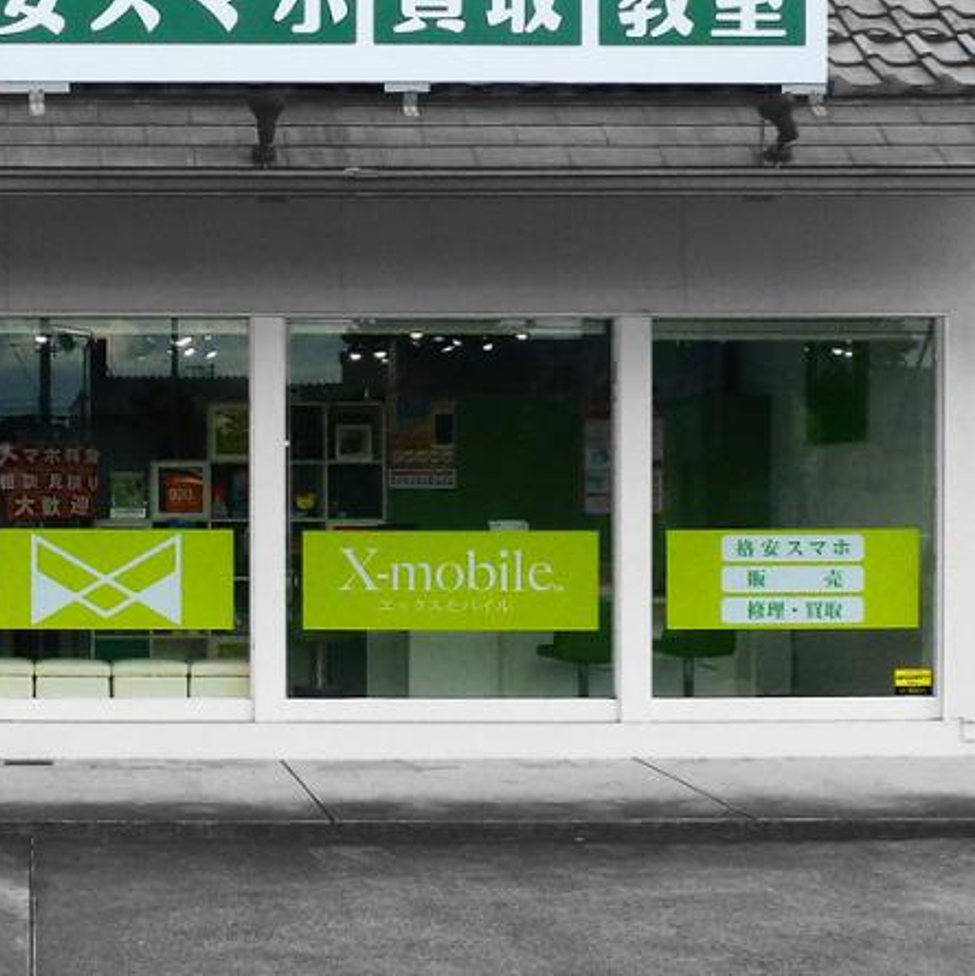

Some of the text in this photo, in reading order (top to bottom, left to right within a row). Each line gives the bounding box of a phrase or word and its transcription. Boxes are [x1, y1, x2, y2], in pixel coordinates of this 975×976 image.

[737, 539, 851, 557] 格安スマホ
[340, 547, 554, 592] X-mobile
[748, 601, 843, 620] 修理・買取
